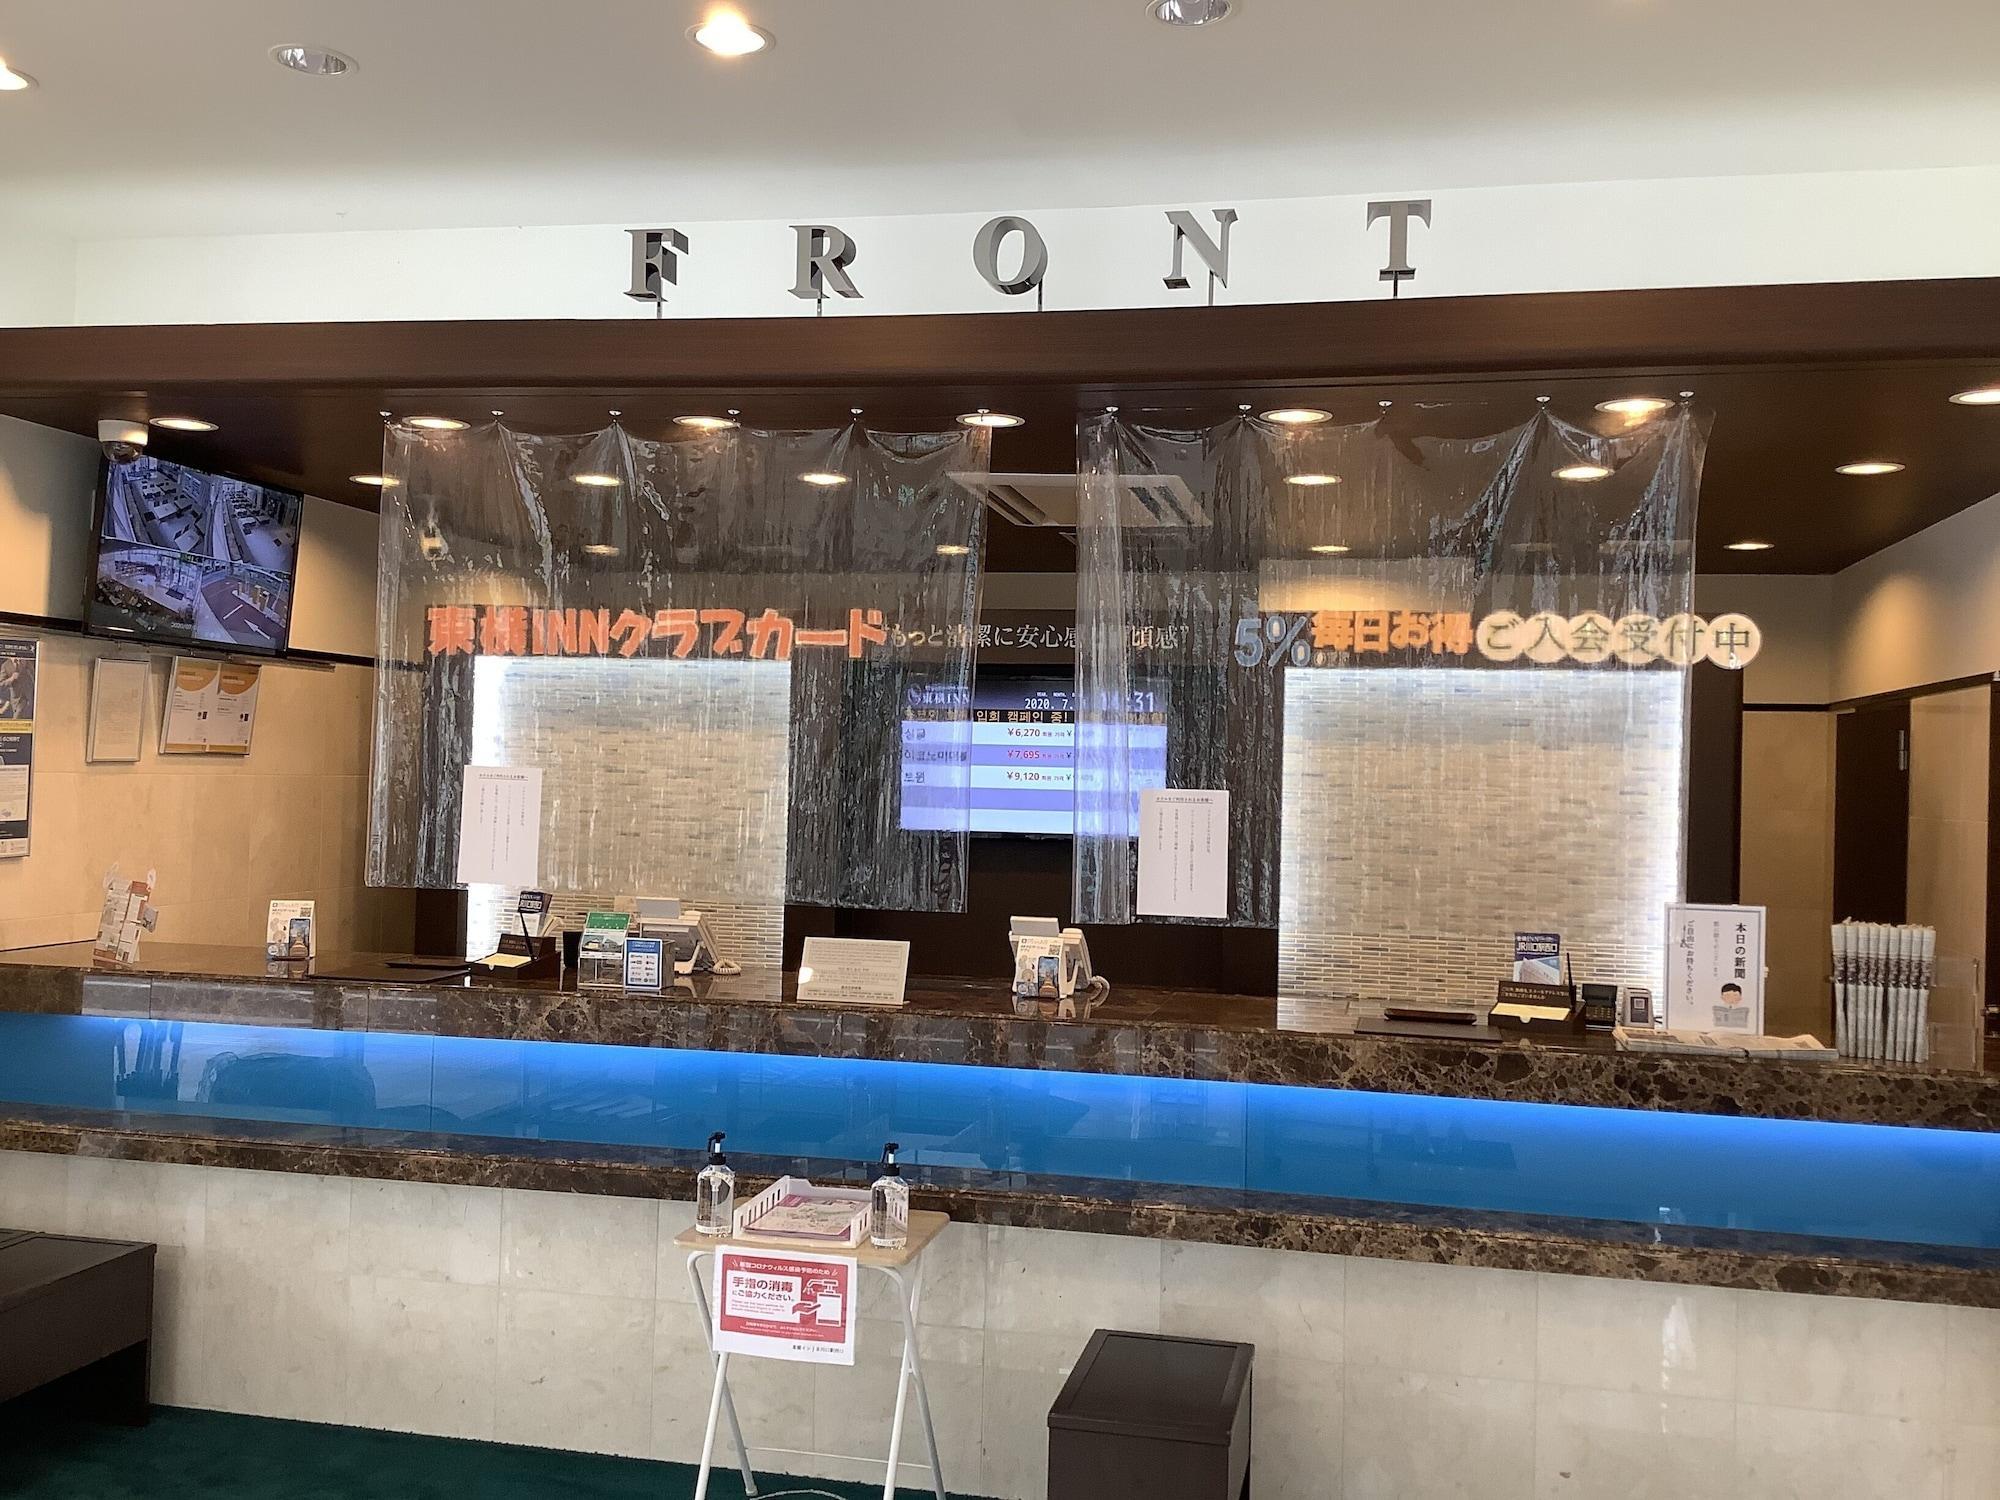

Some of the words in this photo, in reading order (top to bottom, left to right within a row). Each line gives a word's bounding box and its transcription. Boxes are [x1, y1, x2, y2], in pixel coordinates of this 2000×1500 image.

[623, 198, 1433, 303] FRONT
[1484, 616, 1750, 662] ご入会受付中
[976, 710, 1000, 723] 입회
[1007, 711, 1044, 723] 캠페인
[1050, 711, 1068, 723] 중!
[1007, 728, 1041, 739] ¥6,270
[1007, 750, 1040, 761] ¥7,695
[1006, 771, 1040, 782] ¥9,120
[1734, 922, 1748, 980] 本日の新聞
[732, 1276, 794, 1293] 手指の消毒
[731, 1289, 795, 1302] にご協力ください。
